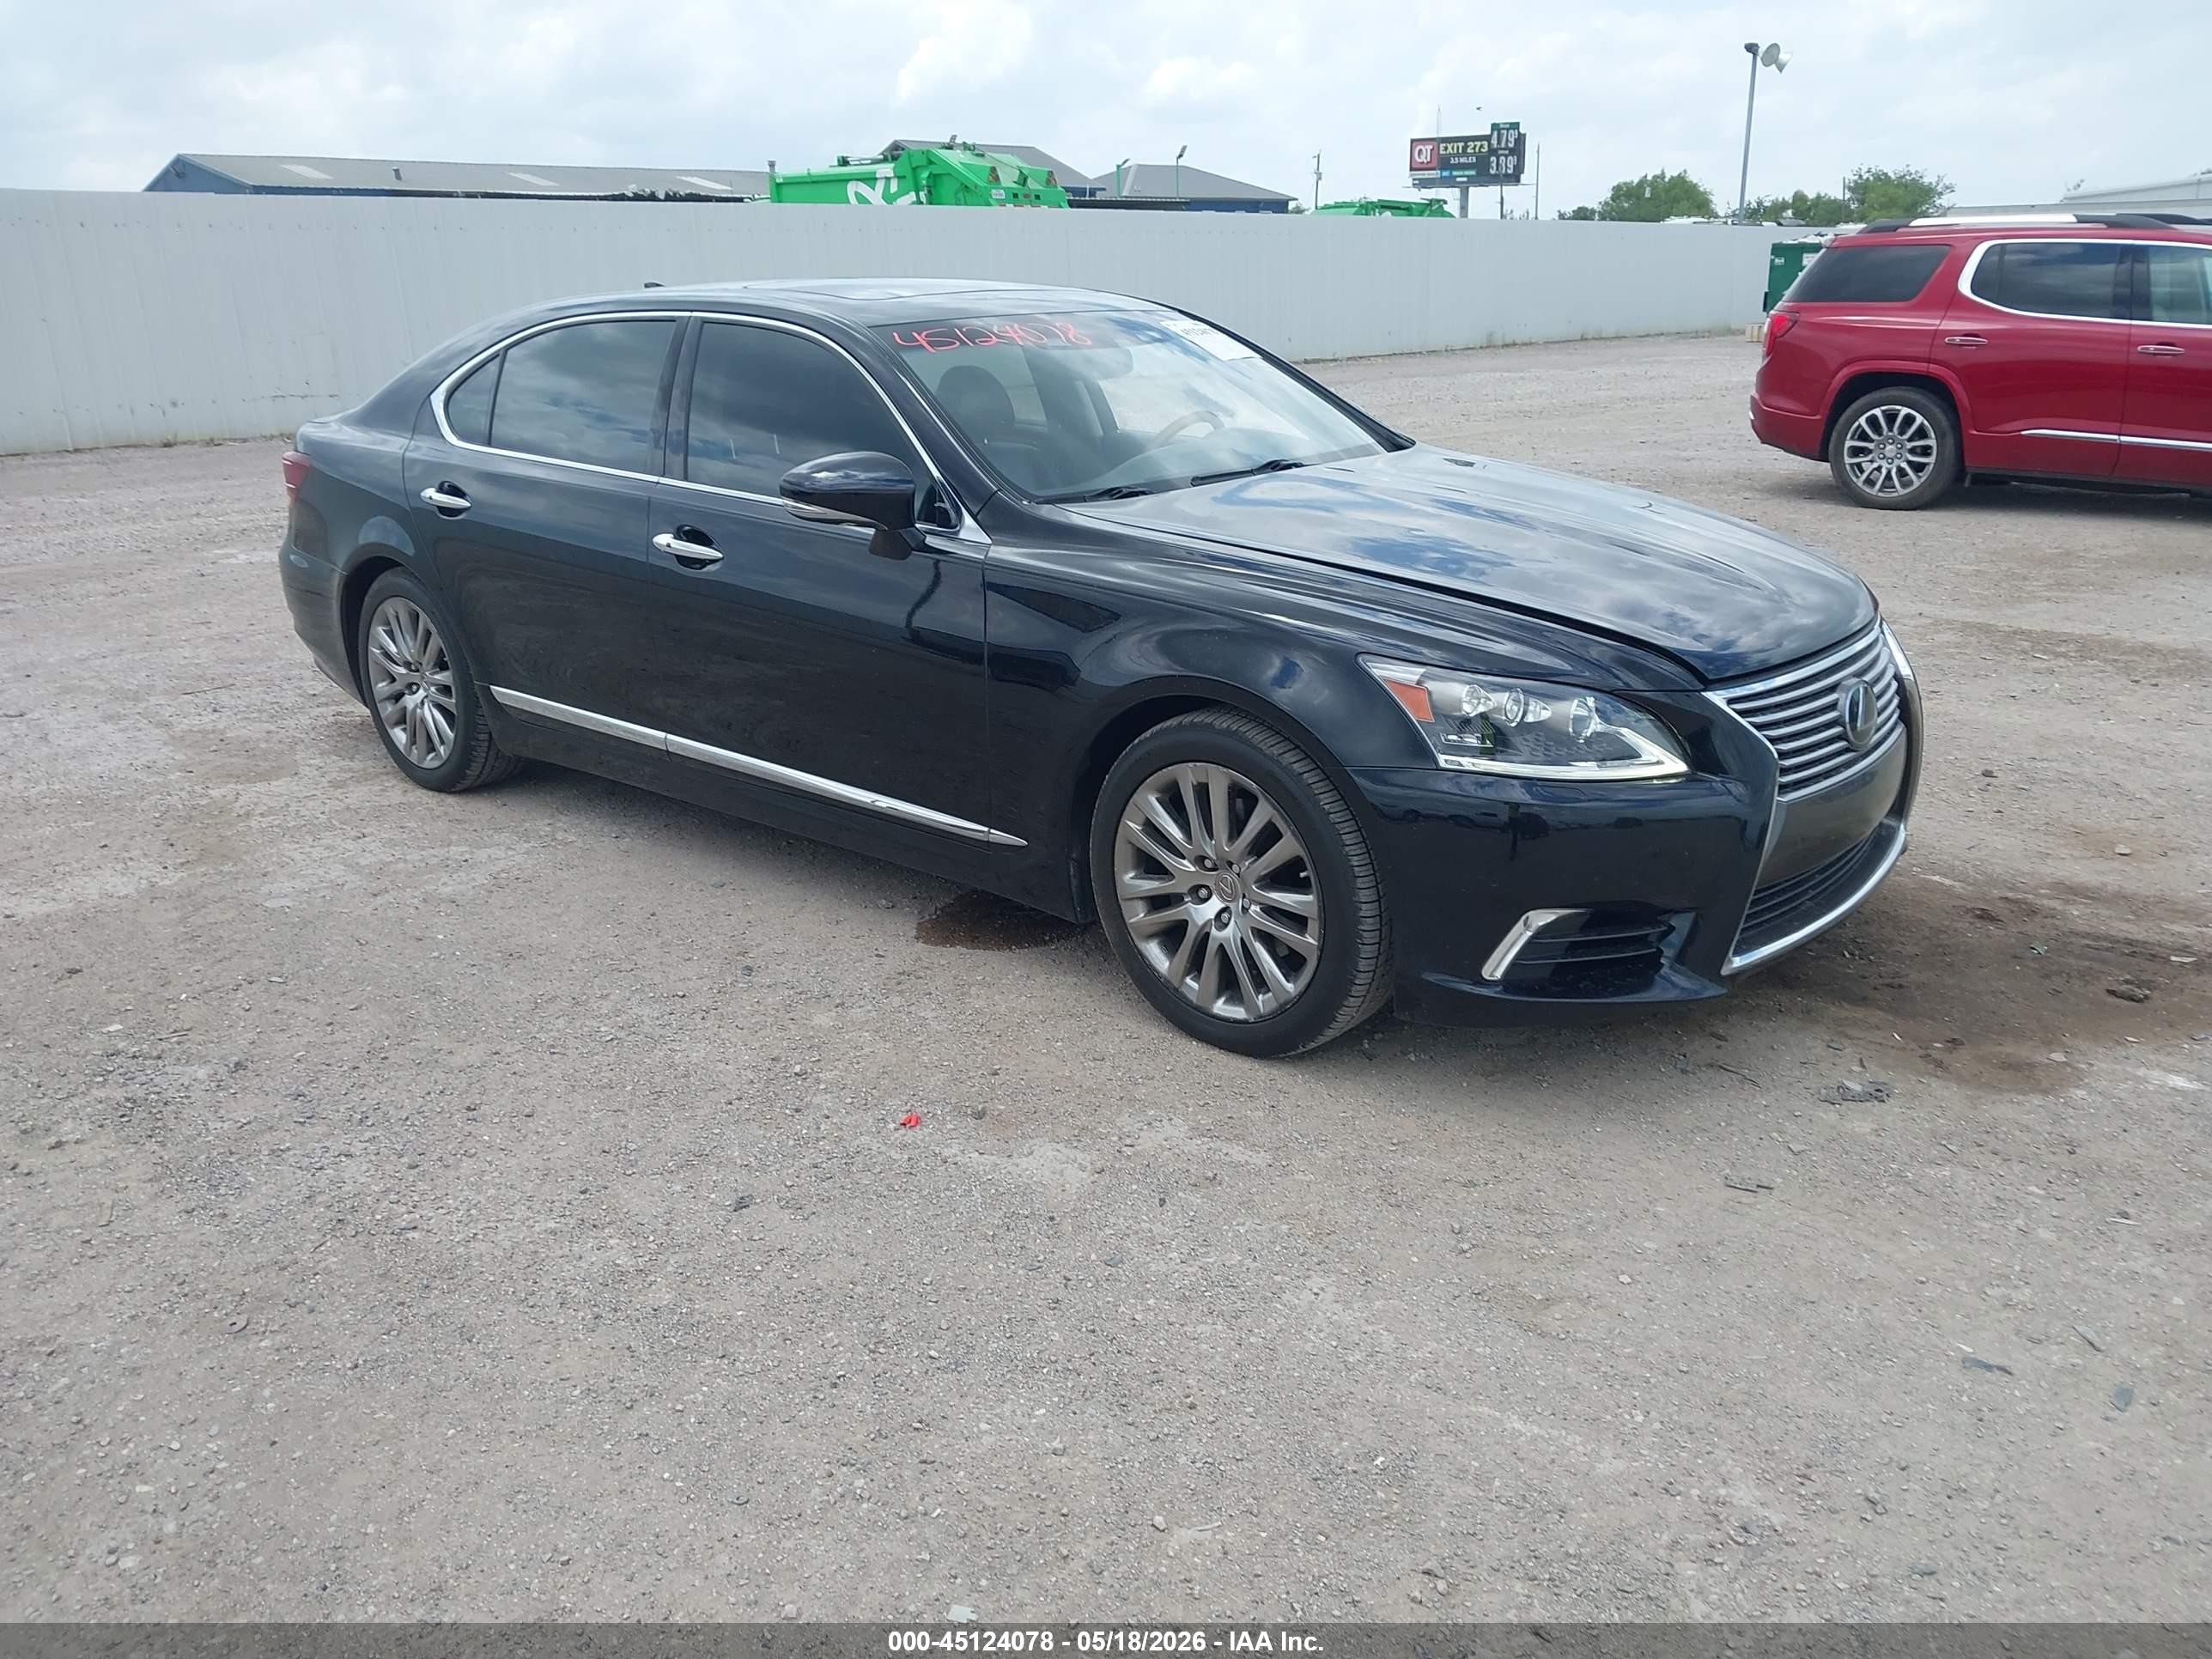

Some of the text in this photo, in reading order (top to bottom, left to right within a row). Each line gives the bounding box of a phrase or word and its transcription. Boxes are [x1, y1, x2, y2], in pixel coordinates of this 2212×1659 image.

[1414, 144, 1433, 163] QT
[1439, 141, 1488, 155] EXIT 273
